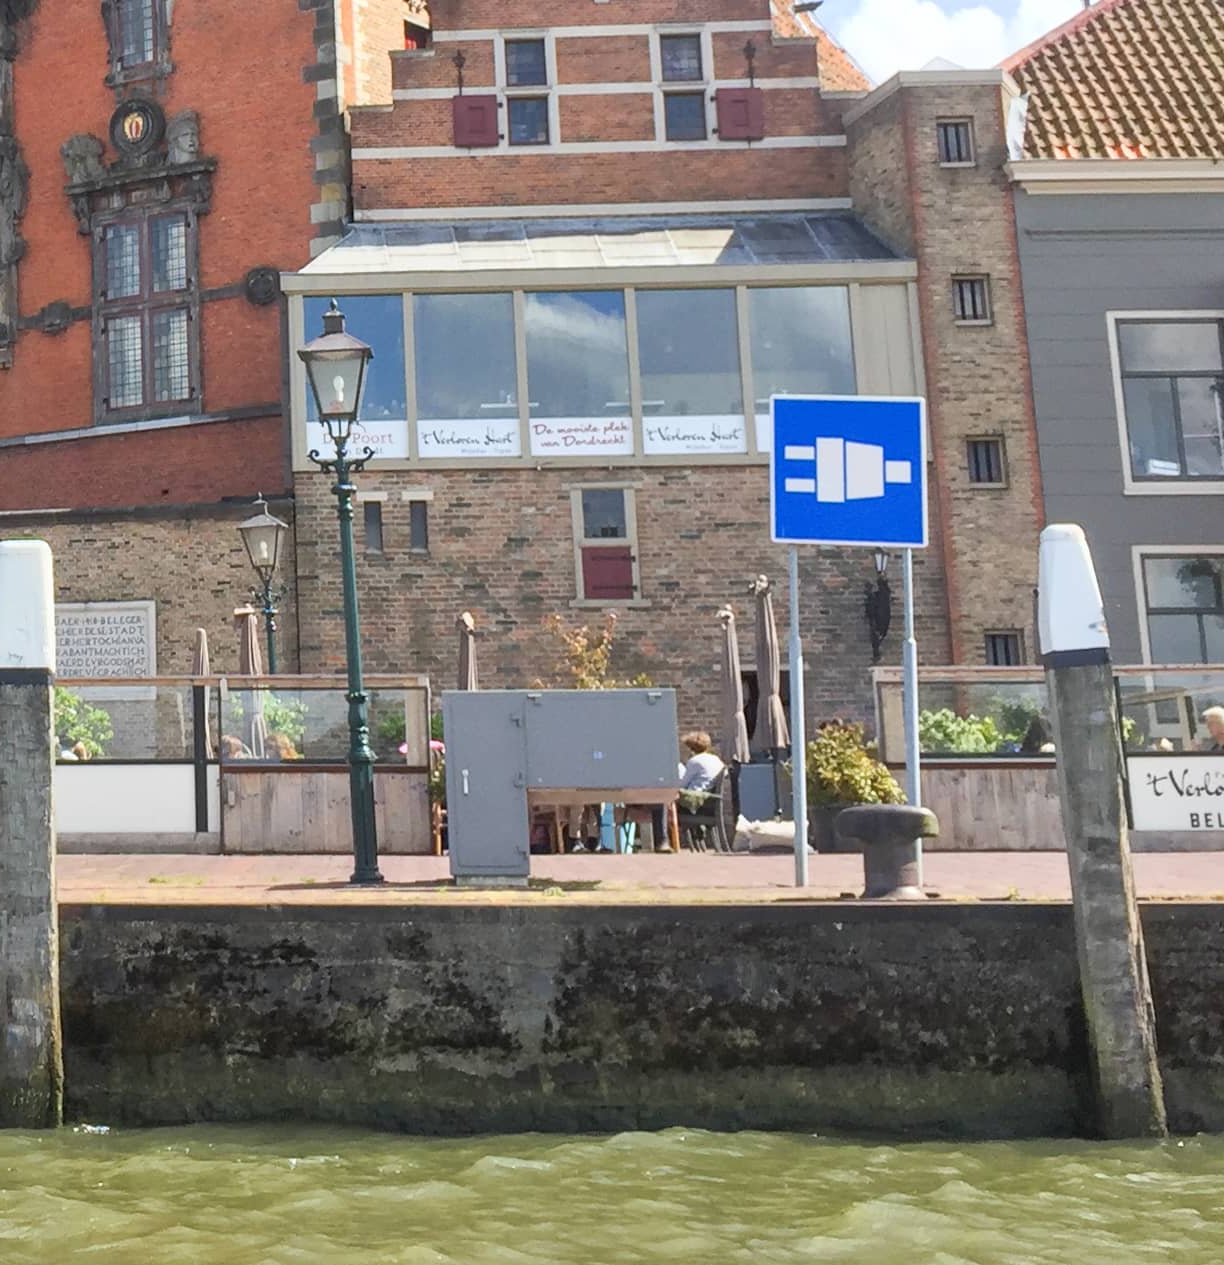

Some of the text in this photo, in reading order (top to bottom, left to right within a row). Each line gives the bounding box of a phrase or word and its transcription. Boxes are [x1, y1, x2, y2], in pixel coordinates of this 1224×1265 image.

[533, 423, 553, 435] De
[603, 421, 629, 435] plek
[352, 433, 394, 444] Poort
[561, 435, 625, 447] Dordrecht
[1146, 772, 1168, 796] 't
[1190, 813, 1224, 828] BEL
